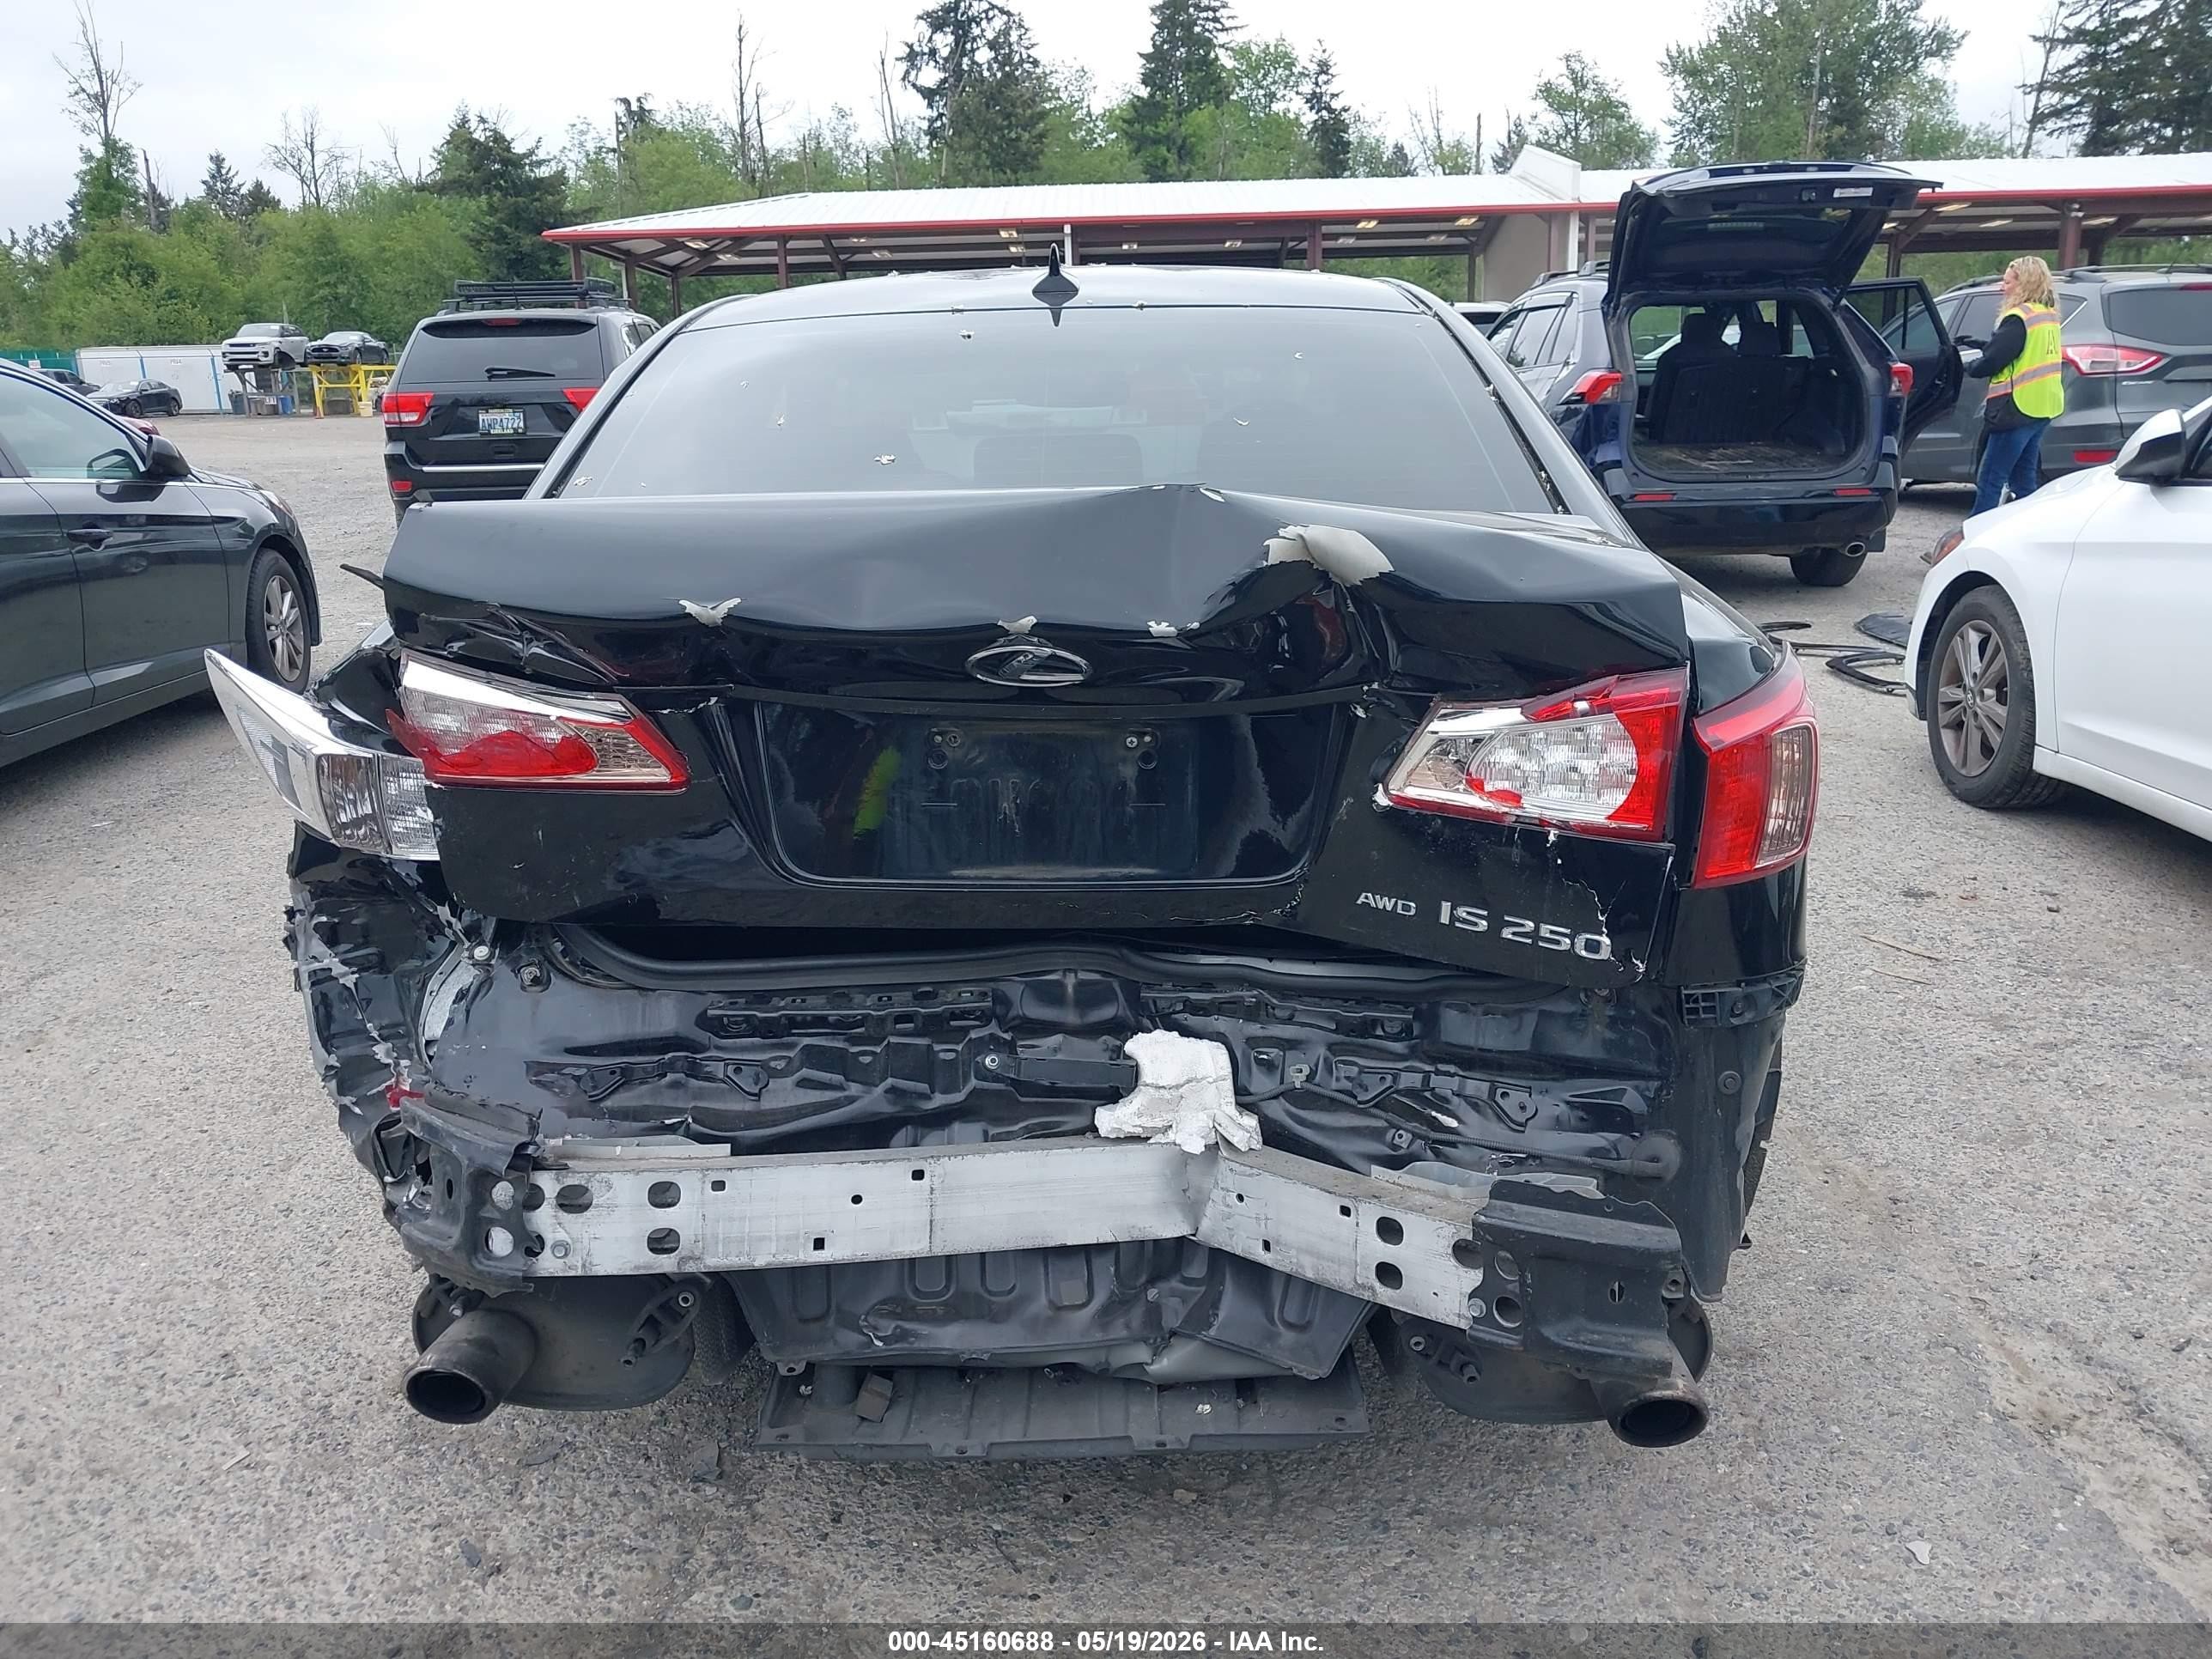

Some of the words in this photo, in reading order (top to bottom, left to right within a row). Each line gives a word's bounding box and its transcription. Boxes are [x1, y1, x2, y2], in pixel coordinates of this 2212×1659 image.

[1356, 891, 1417, 916] AWD
[1438, 900, 1489, 933] IS
[1499, 915, 1612, 961] 250
